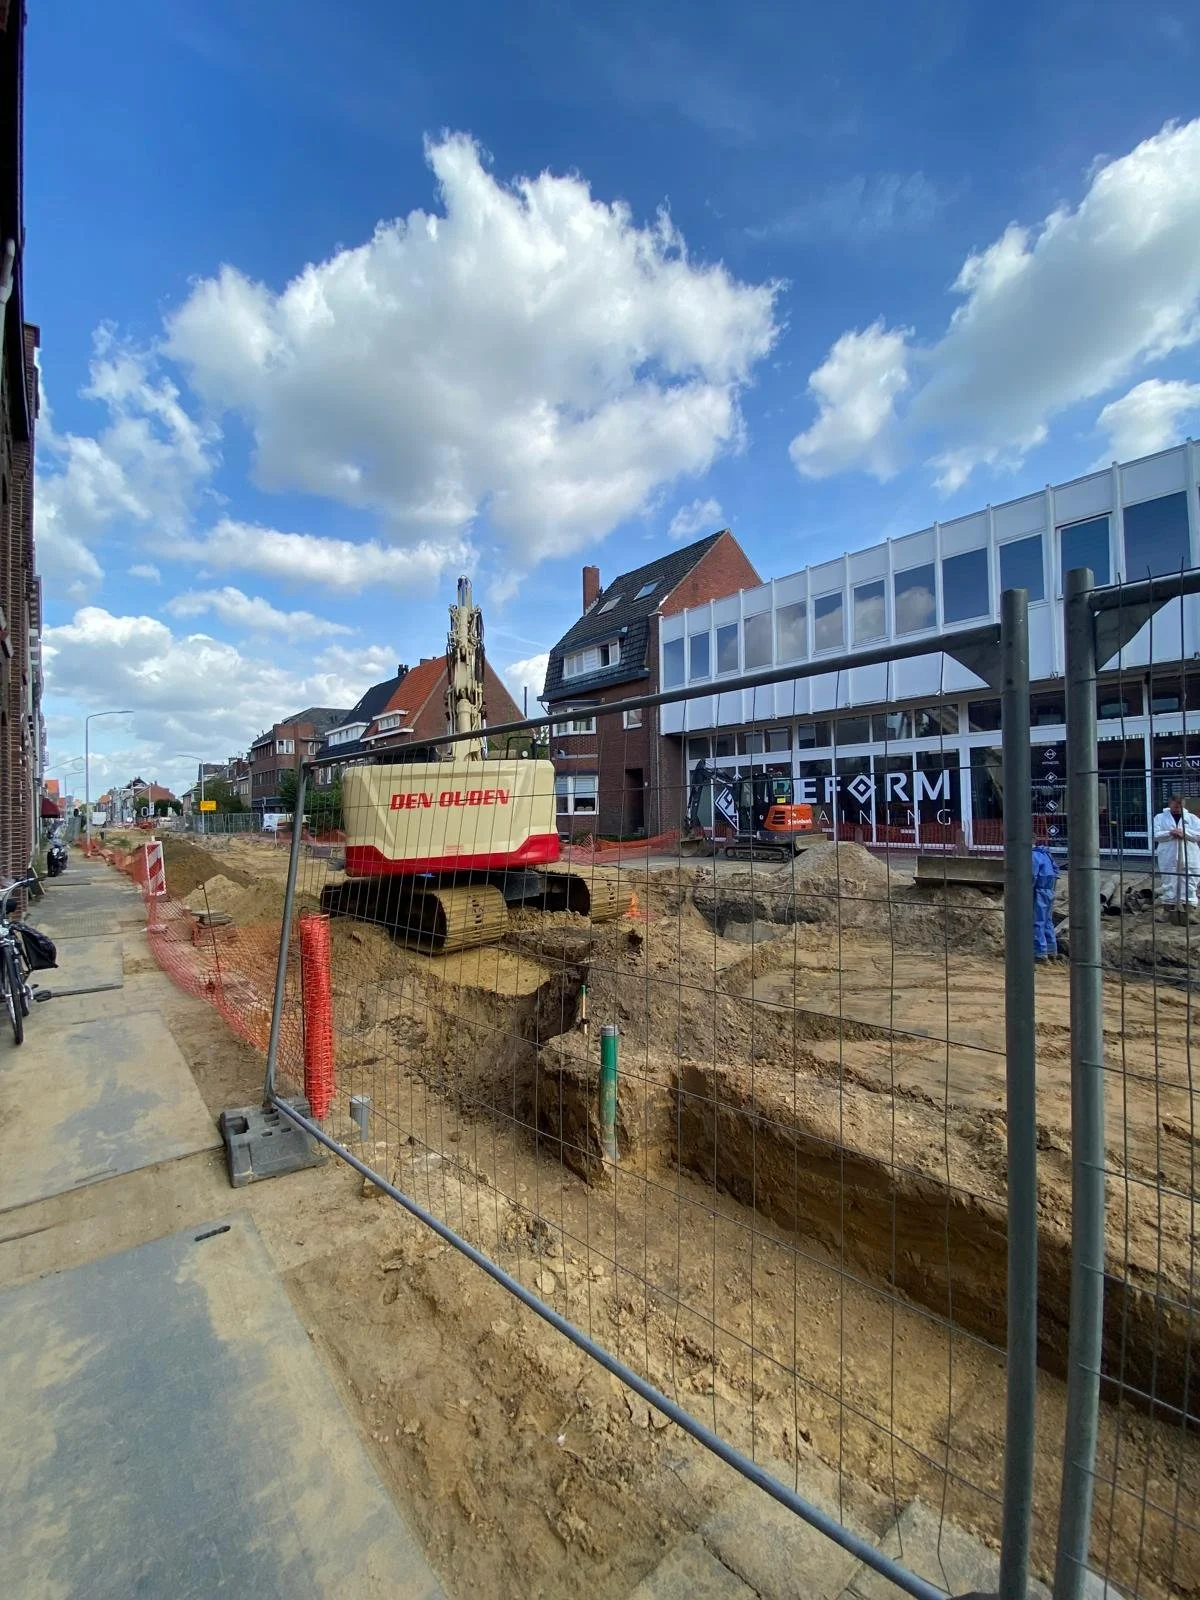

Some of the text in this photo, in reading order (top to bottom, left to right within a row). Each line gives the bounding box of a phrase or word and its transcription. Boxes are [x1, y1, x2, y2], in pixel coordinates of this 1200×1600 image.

[390, 788, 511, 810] DEN OUDEN
[818, 808, 953, 826] AINING
